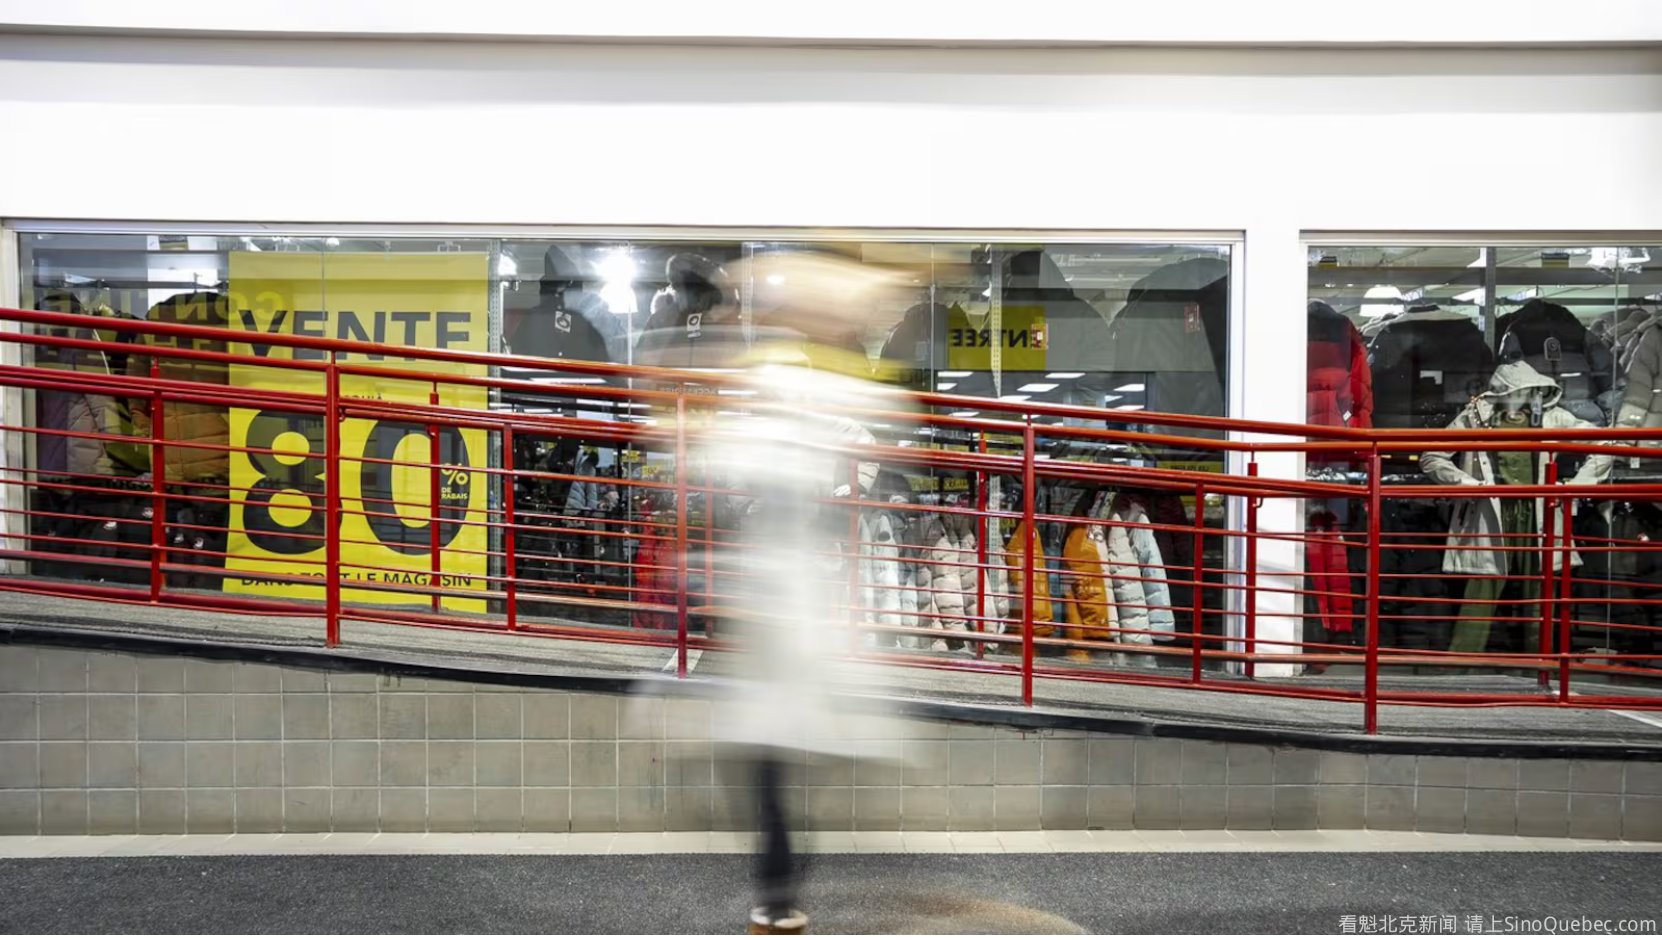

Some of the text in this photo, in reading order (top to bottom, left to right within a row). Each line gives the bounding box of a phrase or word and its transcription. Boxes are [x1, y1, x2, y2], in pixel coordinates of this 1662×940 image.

[238, 309, 472, 361] VENTE
[243, 409, 470, 555] 80
[441, 462, 469, 486] %
